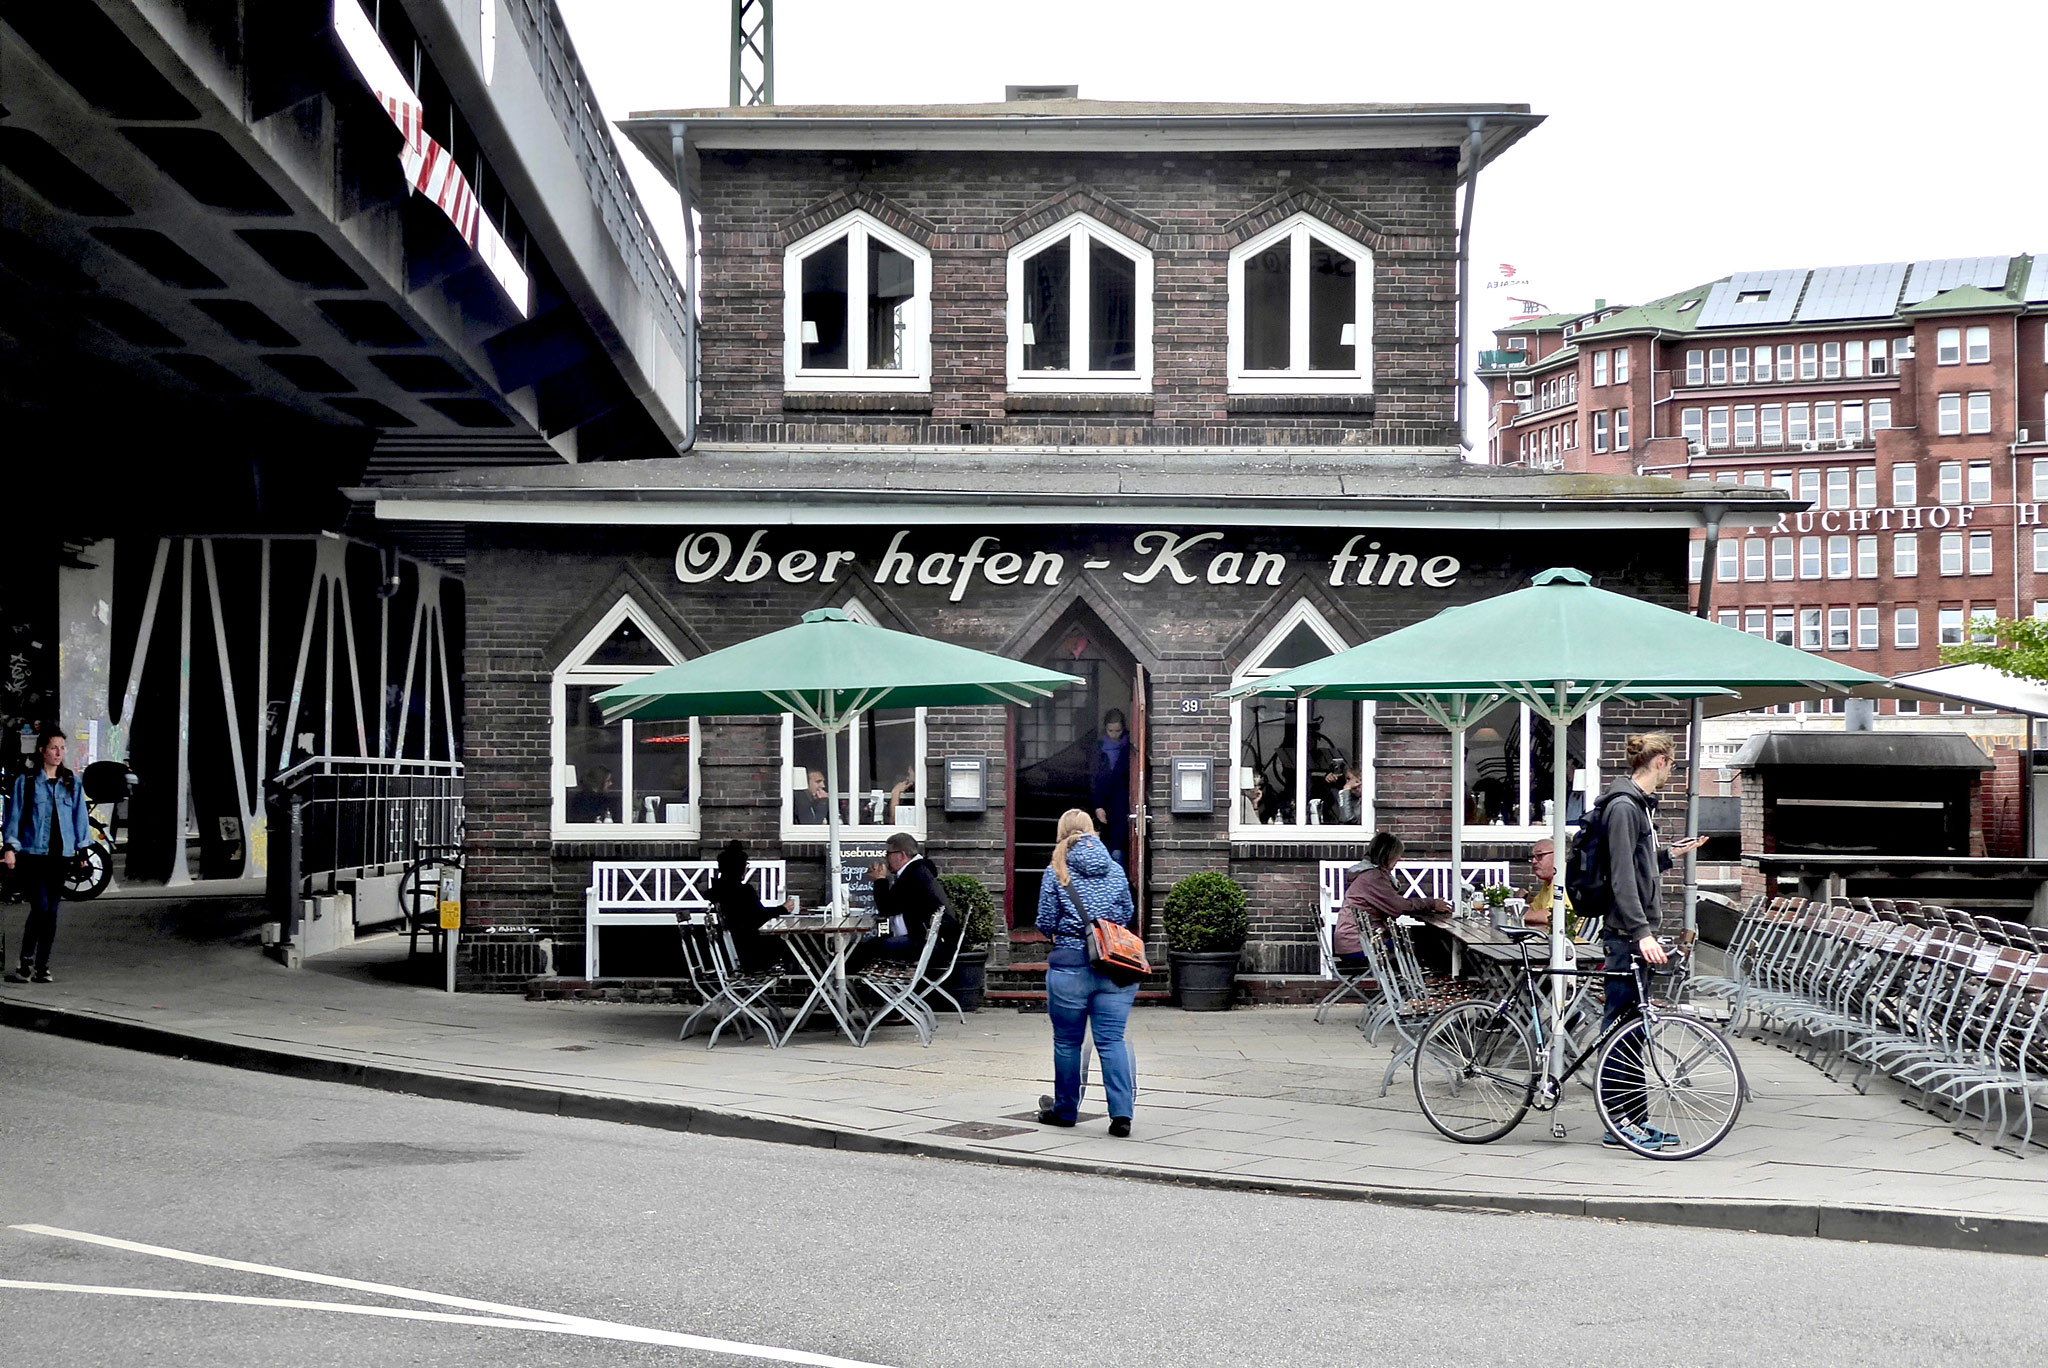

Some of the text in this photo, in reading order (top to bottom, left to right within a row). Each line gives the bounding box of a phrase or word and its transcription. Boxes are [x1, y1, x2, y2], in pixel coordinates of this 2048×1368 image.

[1746, 503, 2043, 535] RUCHTHOF H
[675, 529, 856, 584] Ober
[873, 530, 1064, 603] hafen
[1122, 530, 1286, 587] Kan
[1181, 699, 1198, 713] 39
